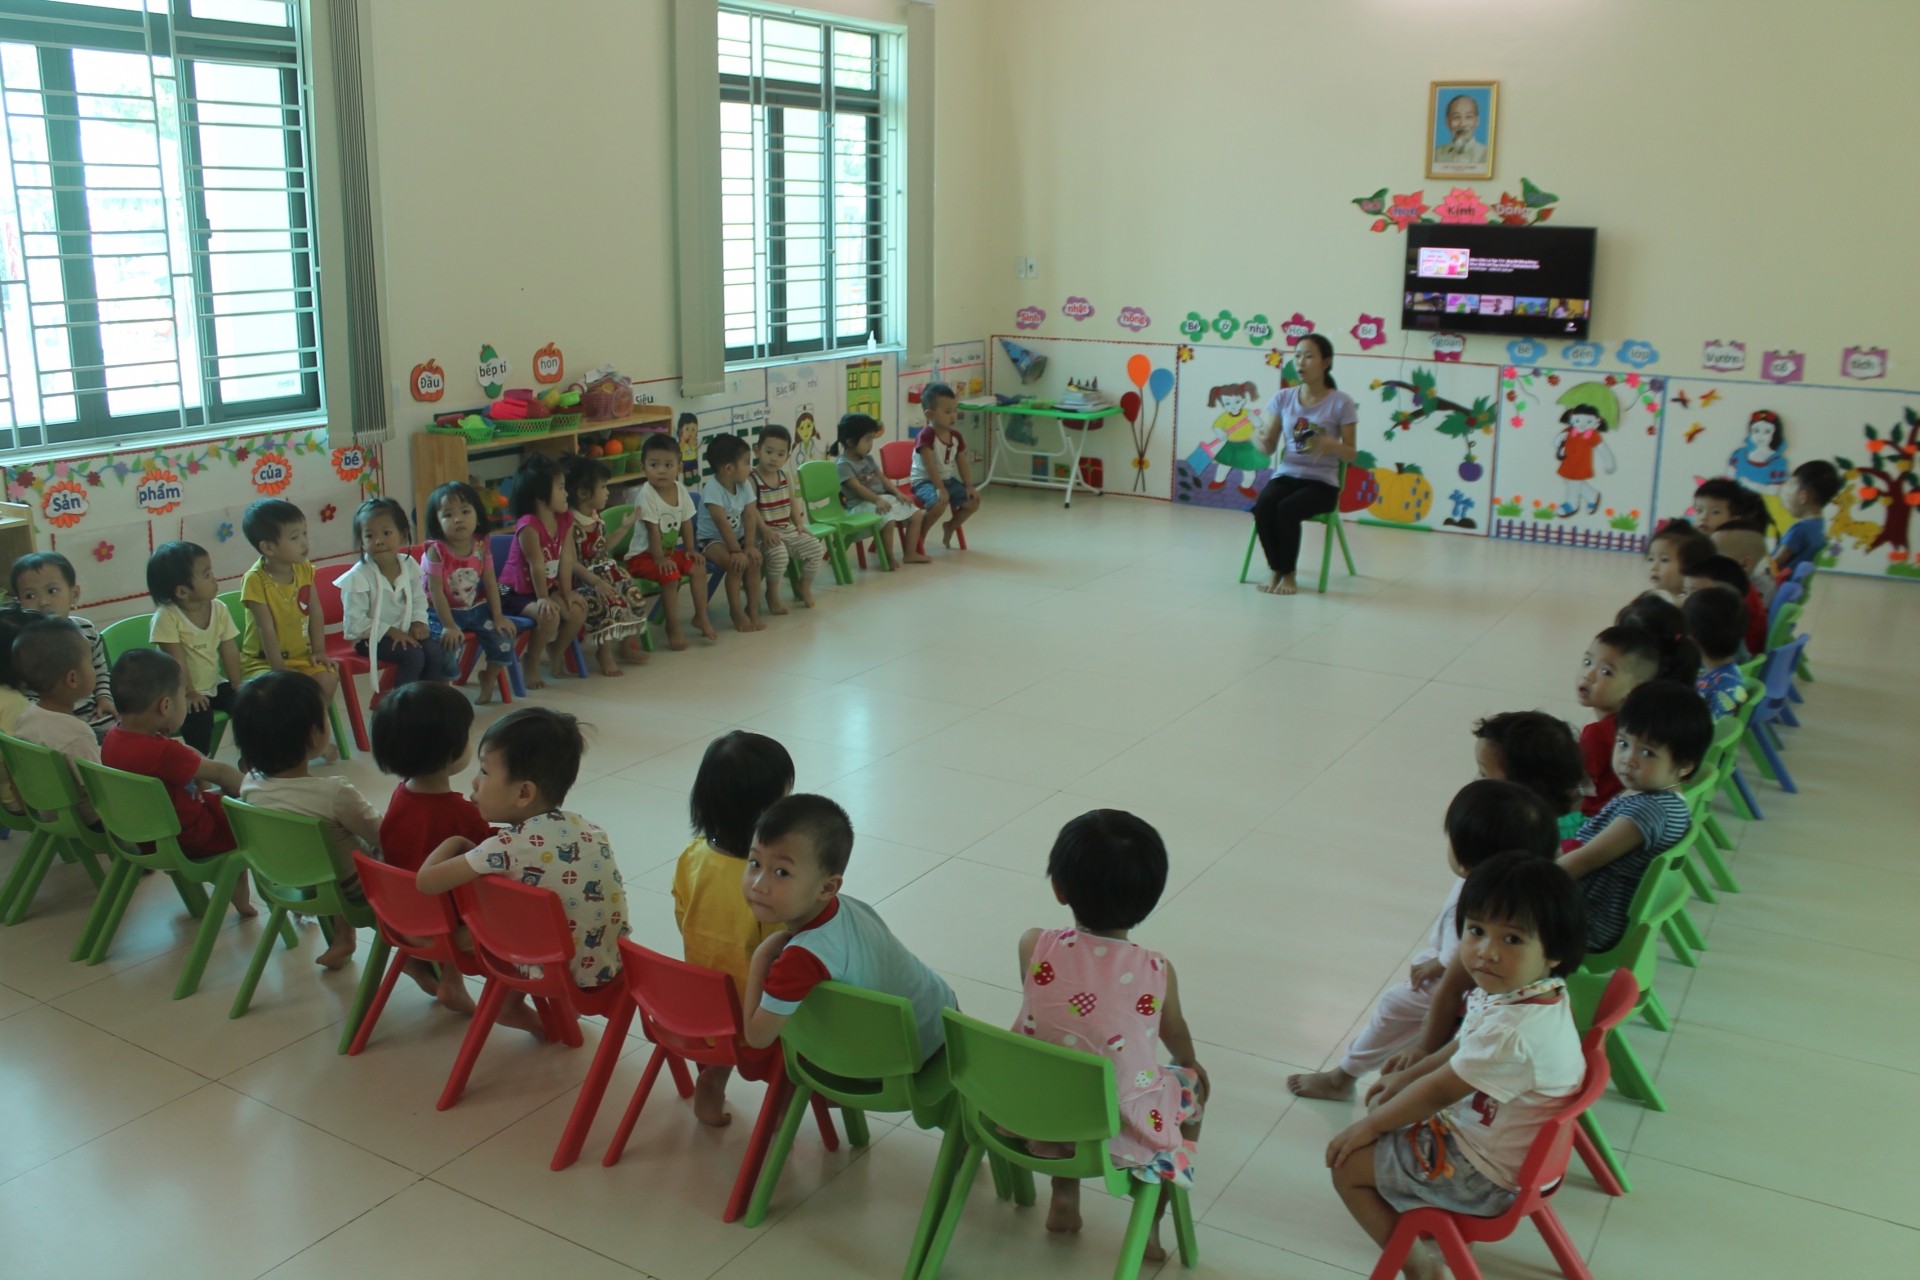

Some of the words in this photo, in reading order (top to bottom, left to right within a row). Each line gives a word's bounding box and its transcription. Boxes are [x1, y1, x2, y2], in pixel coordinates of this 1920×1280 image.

[1448, 203, 1475, 217] Kính
[1496, 203, 1531, 219] Dâng
[1021, 311, 1040, 322] Sinh
[1067, 302, 1088, 314] nhật
[1188, 320, 1199, 331] Bé
[1250, 322, 1267, 335] nhà
[1517, 343, 1531, 355] Bé
[1572, 346, 1593, 360] đến
[420, 374, 440, 389] Đầu
[479, 363, 498, 379] bếp
[500, 360, 507, 374] tí
[540, 357, 558, 370] hon
[775, 384, 788, 396] Bác
[52, 494, 82, 513] Sản
[138, 482, 181, 504] phẩm
[259, 463, 283, 481] của
[343, 450, 360, 467] bé
